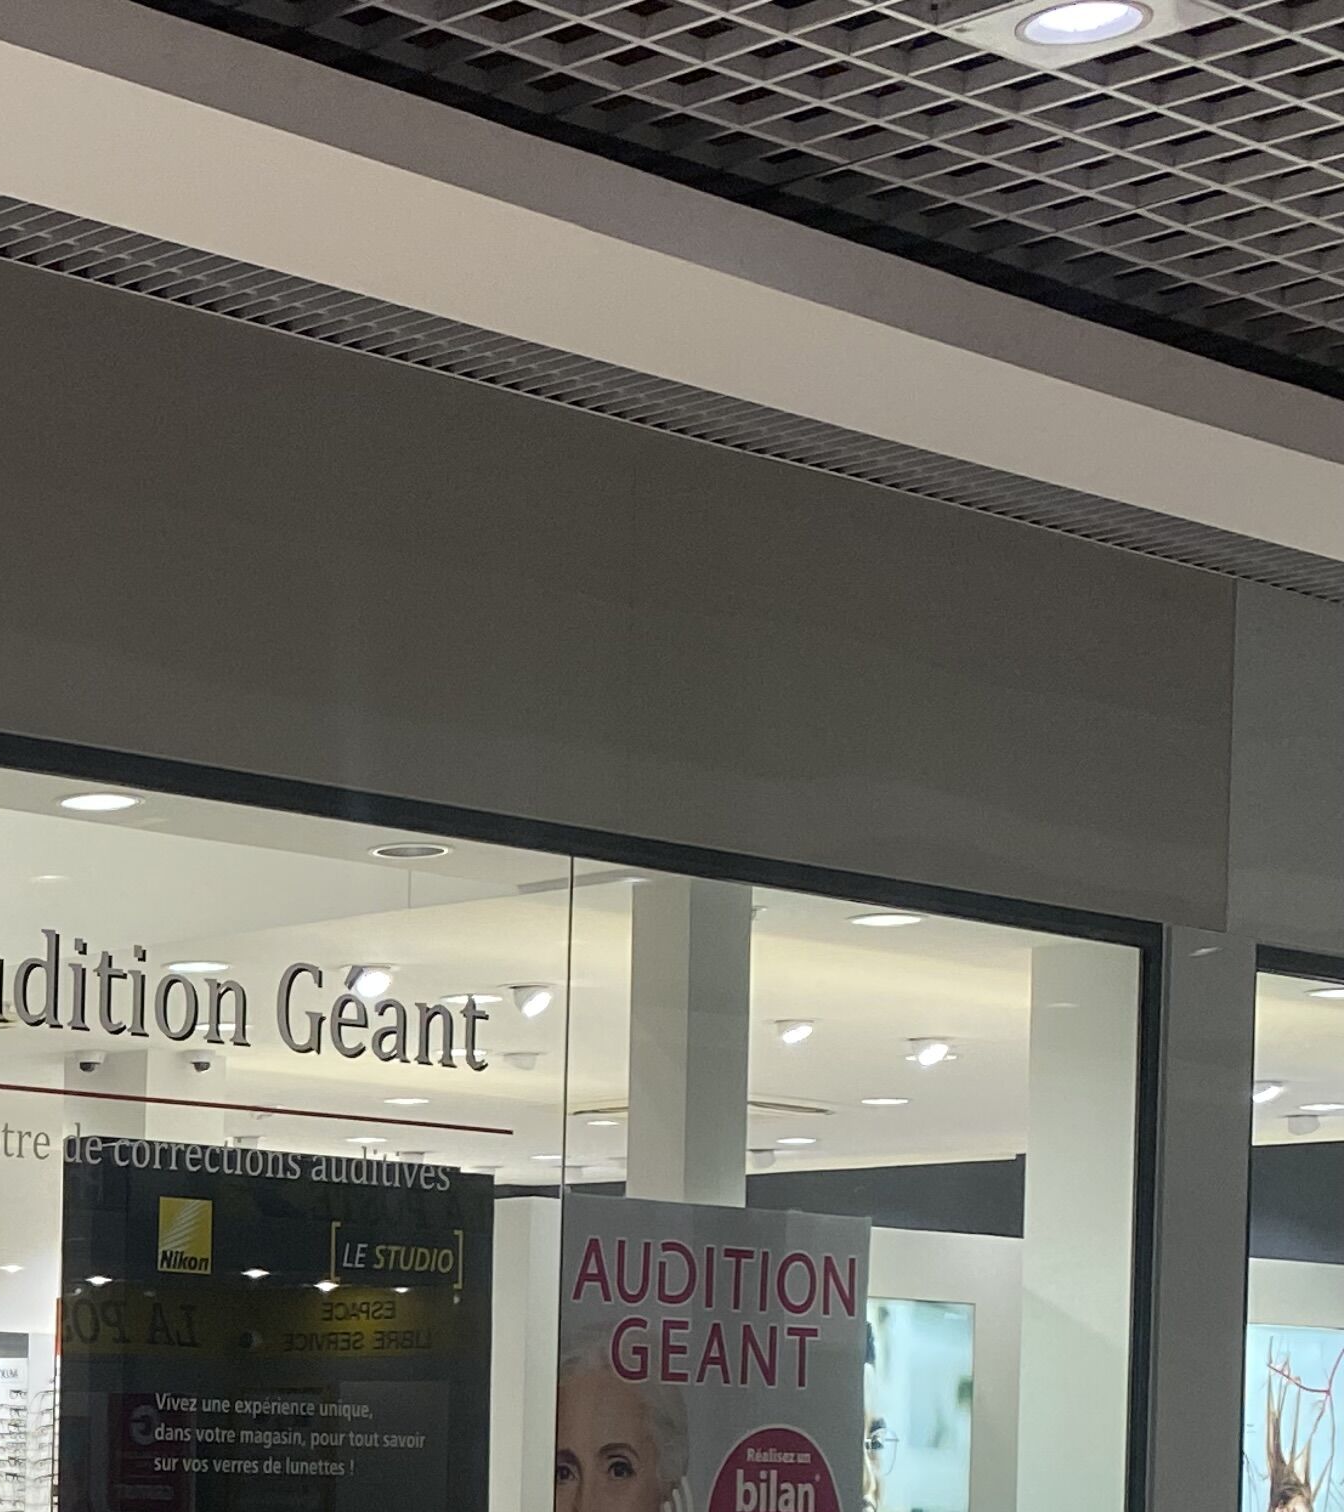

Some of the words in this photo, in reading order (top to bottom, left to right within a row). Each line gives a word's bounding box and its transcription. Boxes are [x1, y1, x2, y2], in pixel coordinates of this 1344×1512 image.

[65, 1123, 104, 1165] de
[114, 1139, 302, 1181] corrections
[311, 1146, 452, 1191] auditives
[159, 1249, 210, 1272] Nikon
[342, 1243, 369, 1268] LE
[373, 1244, 454, 1274] STUDIO
[570, 1235, 858, 1318] AUDITION
[609, 1315, 821, 1390] GEANT
[154, 1392, 197, 1412] Vivez
[201, 1398, 230, 1413] une
[235, 1397, 315, 1418] expérience
[319, 1401, 373, 1421] unique,
[154, 1424, 191, 1442] dans
[196, 1428, 236, 1443] votre
[240, 1427, 306, 1448] magasin,
[311, 1431, 343, 1449] pour
[348, 1432, 379, 1448] tout
[383, 1433, 425, 1449] savoir
[154, 1457, 178, 1472] sur
[182, 1458, 209, 1472] vos
[213, 1459, 259, 1474] verres
[263, 1457, 281, 1474] de
[286, 1457, 345, 1476] lunettes
[746, 1448, 796, 1464] Réalisez
[797, 1452, 811, 1464] un
